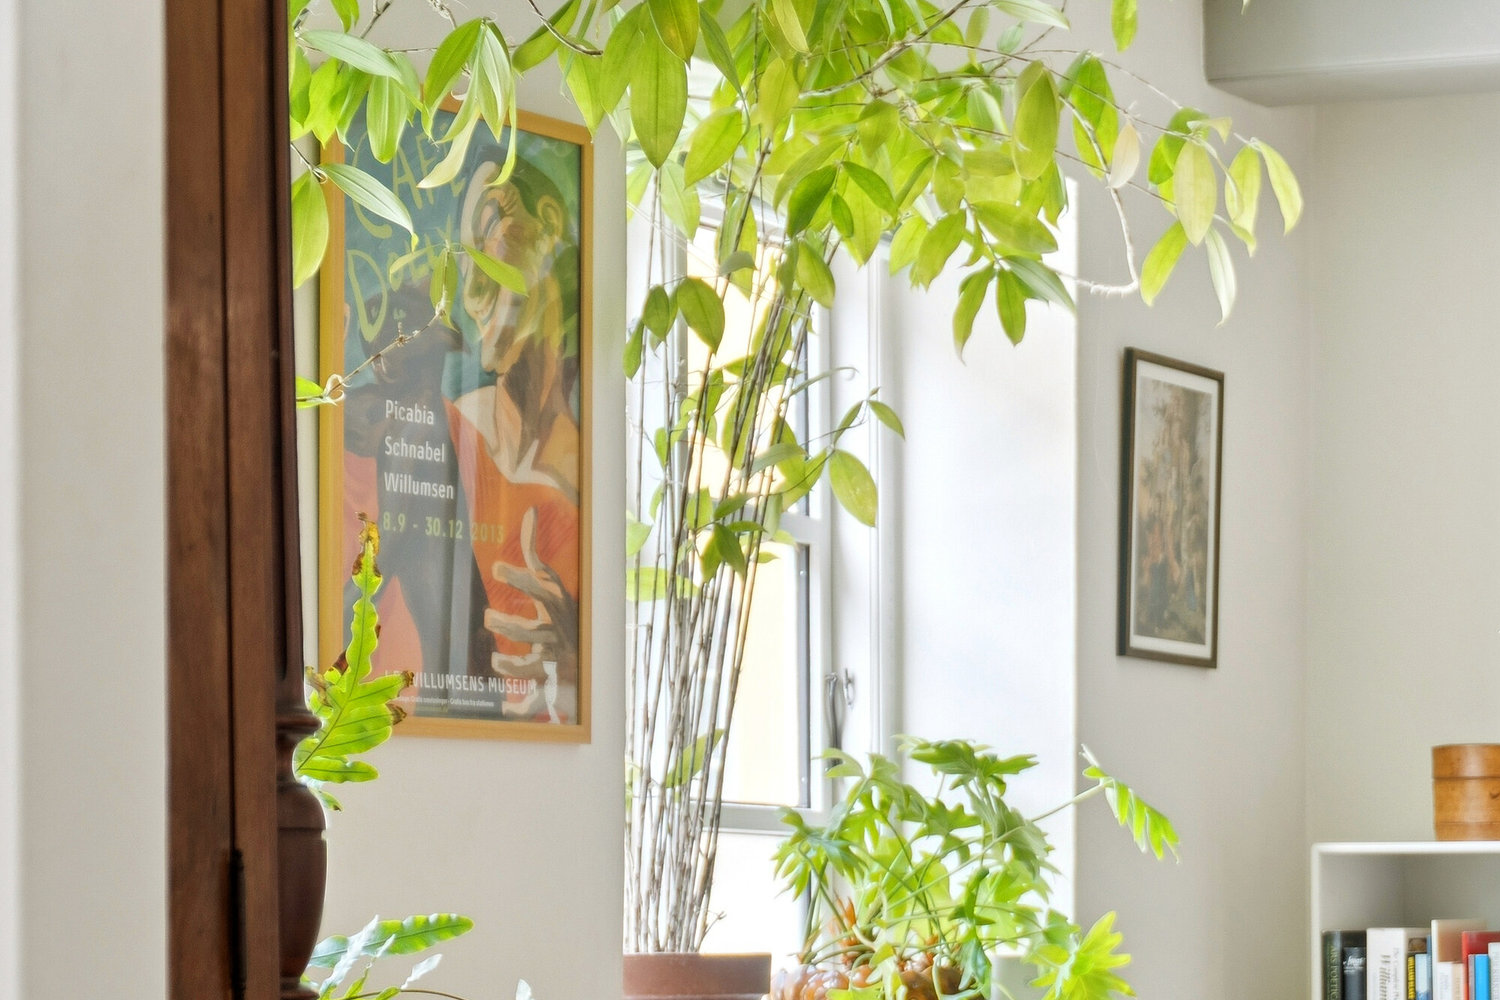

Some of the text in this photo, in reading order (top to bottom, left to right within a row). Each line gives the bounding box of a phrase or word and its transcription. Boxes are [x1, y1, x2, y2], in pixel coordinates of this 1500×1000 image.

[385, 399, 435, 425] Picabia
[384, 435, 446, 463] Schnabel
[384, 471, 454, 500] Willumsen
[383, 511, 406, 533] 8.9
[425, 516, 463, 539] 30.12
[471, 523, 504, 544] 2013
[487, 677, 537, 696] MUSEUM
